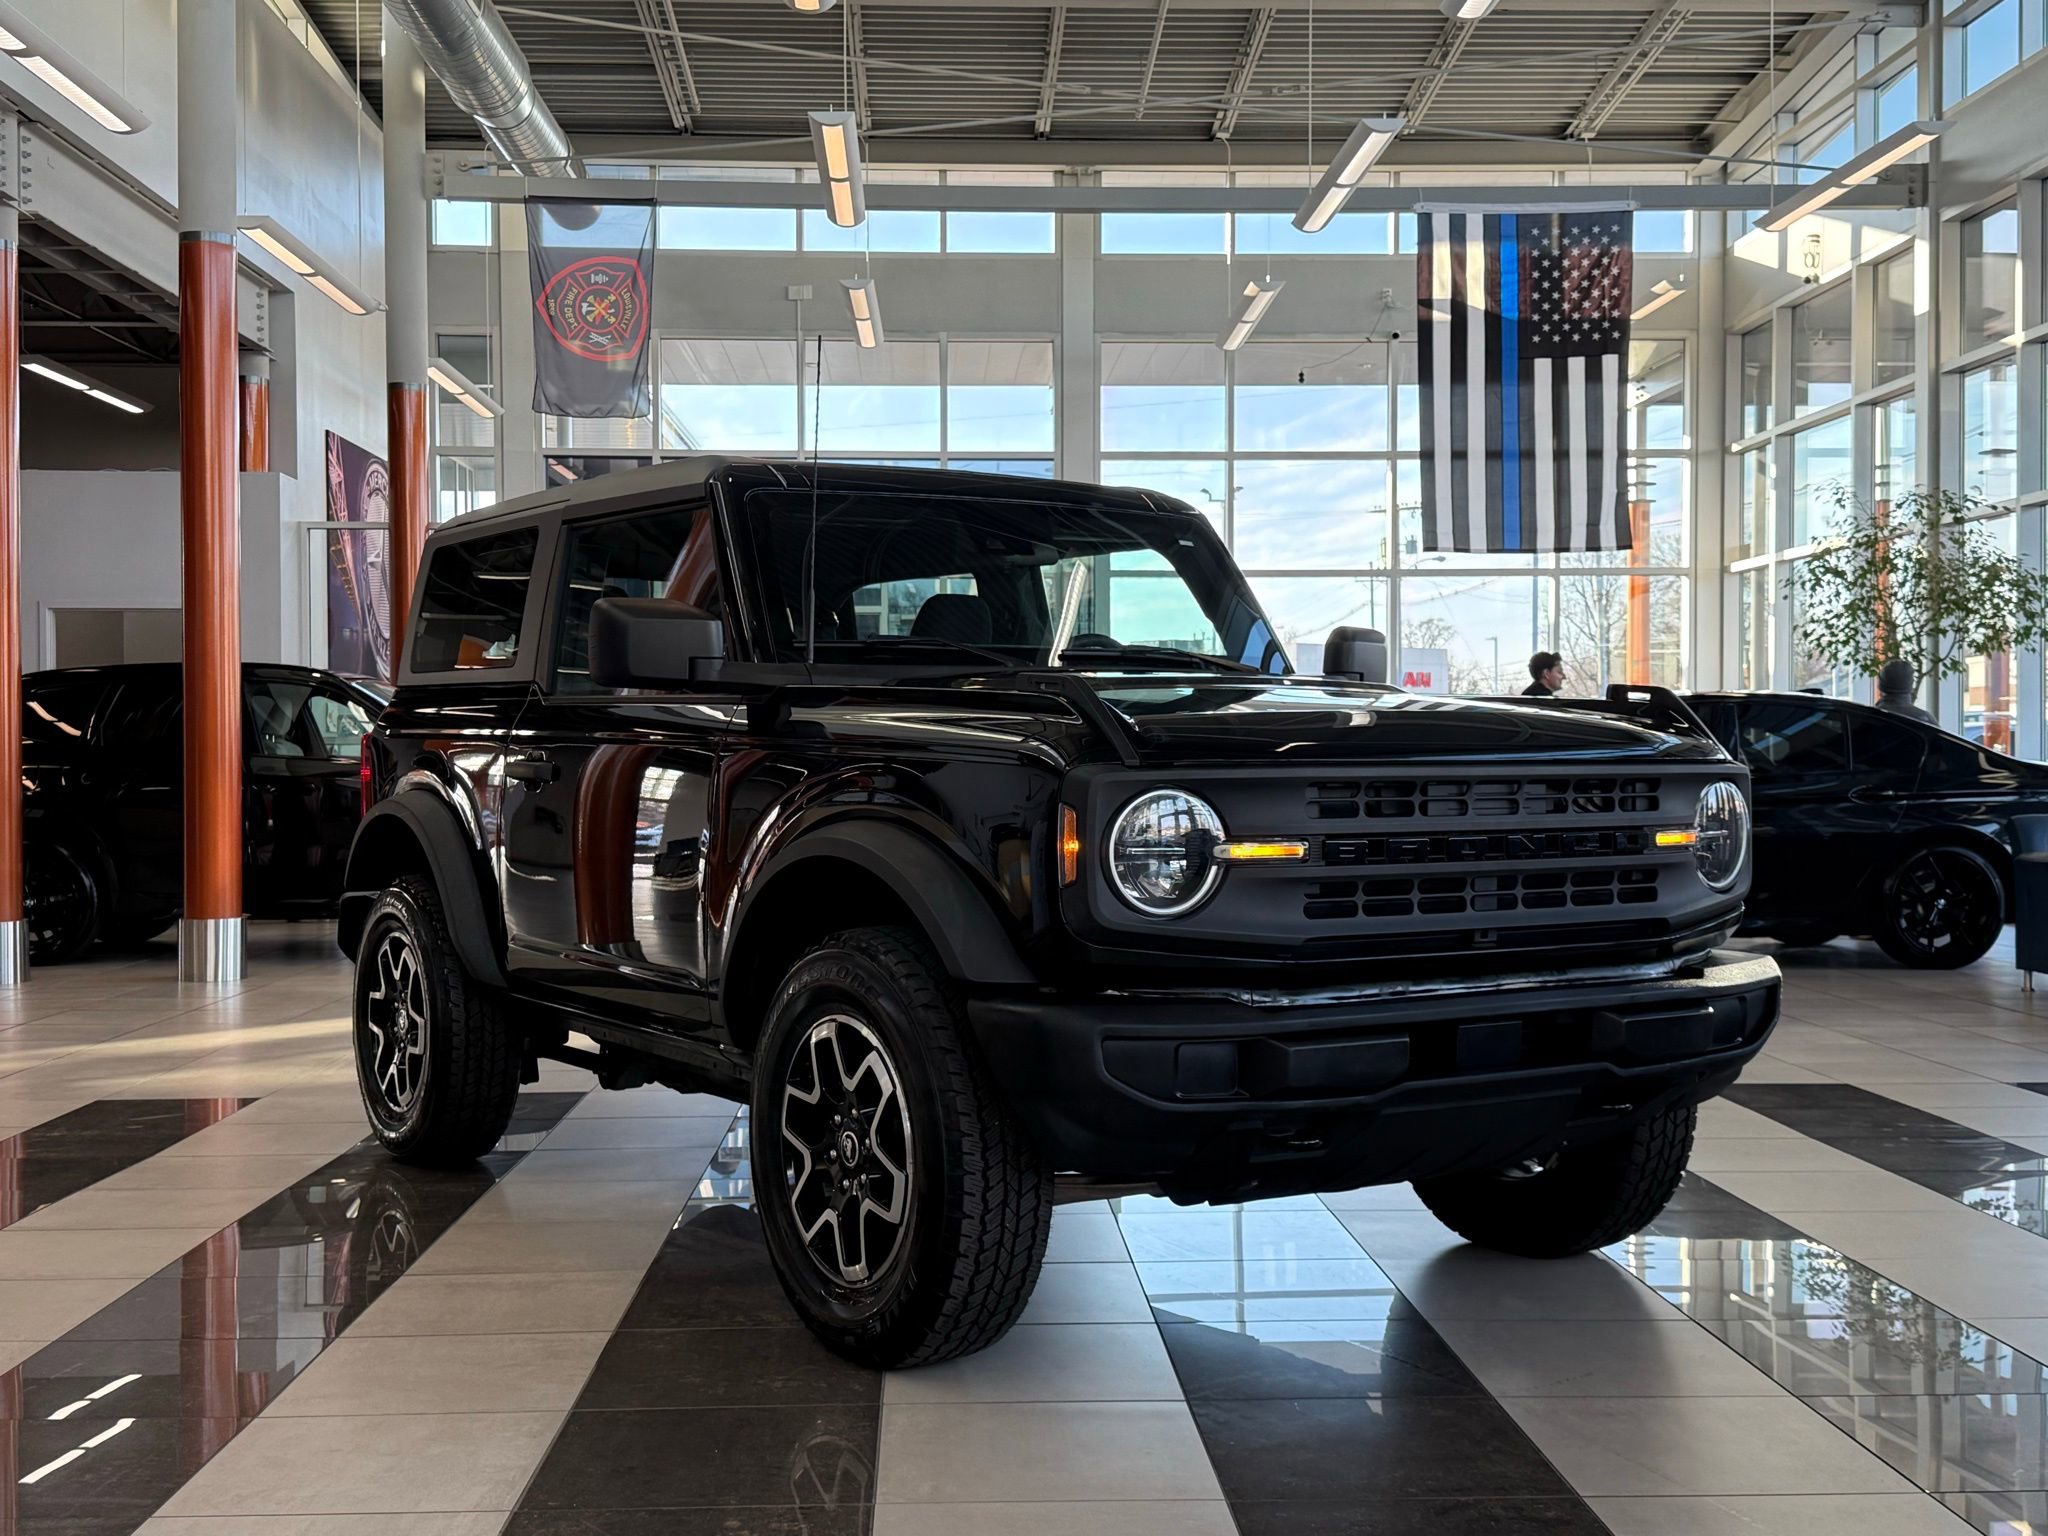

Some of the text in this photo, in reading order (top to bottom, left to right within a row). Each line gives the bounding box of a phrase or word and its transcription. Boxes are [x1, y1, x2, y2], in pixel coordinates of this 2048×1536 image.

[564, 287, 578, 305] FIRE
[620, 287, 633, 330] LOUISVILLE
[1325, 832, 1640, 864] BRONCO
